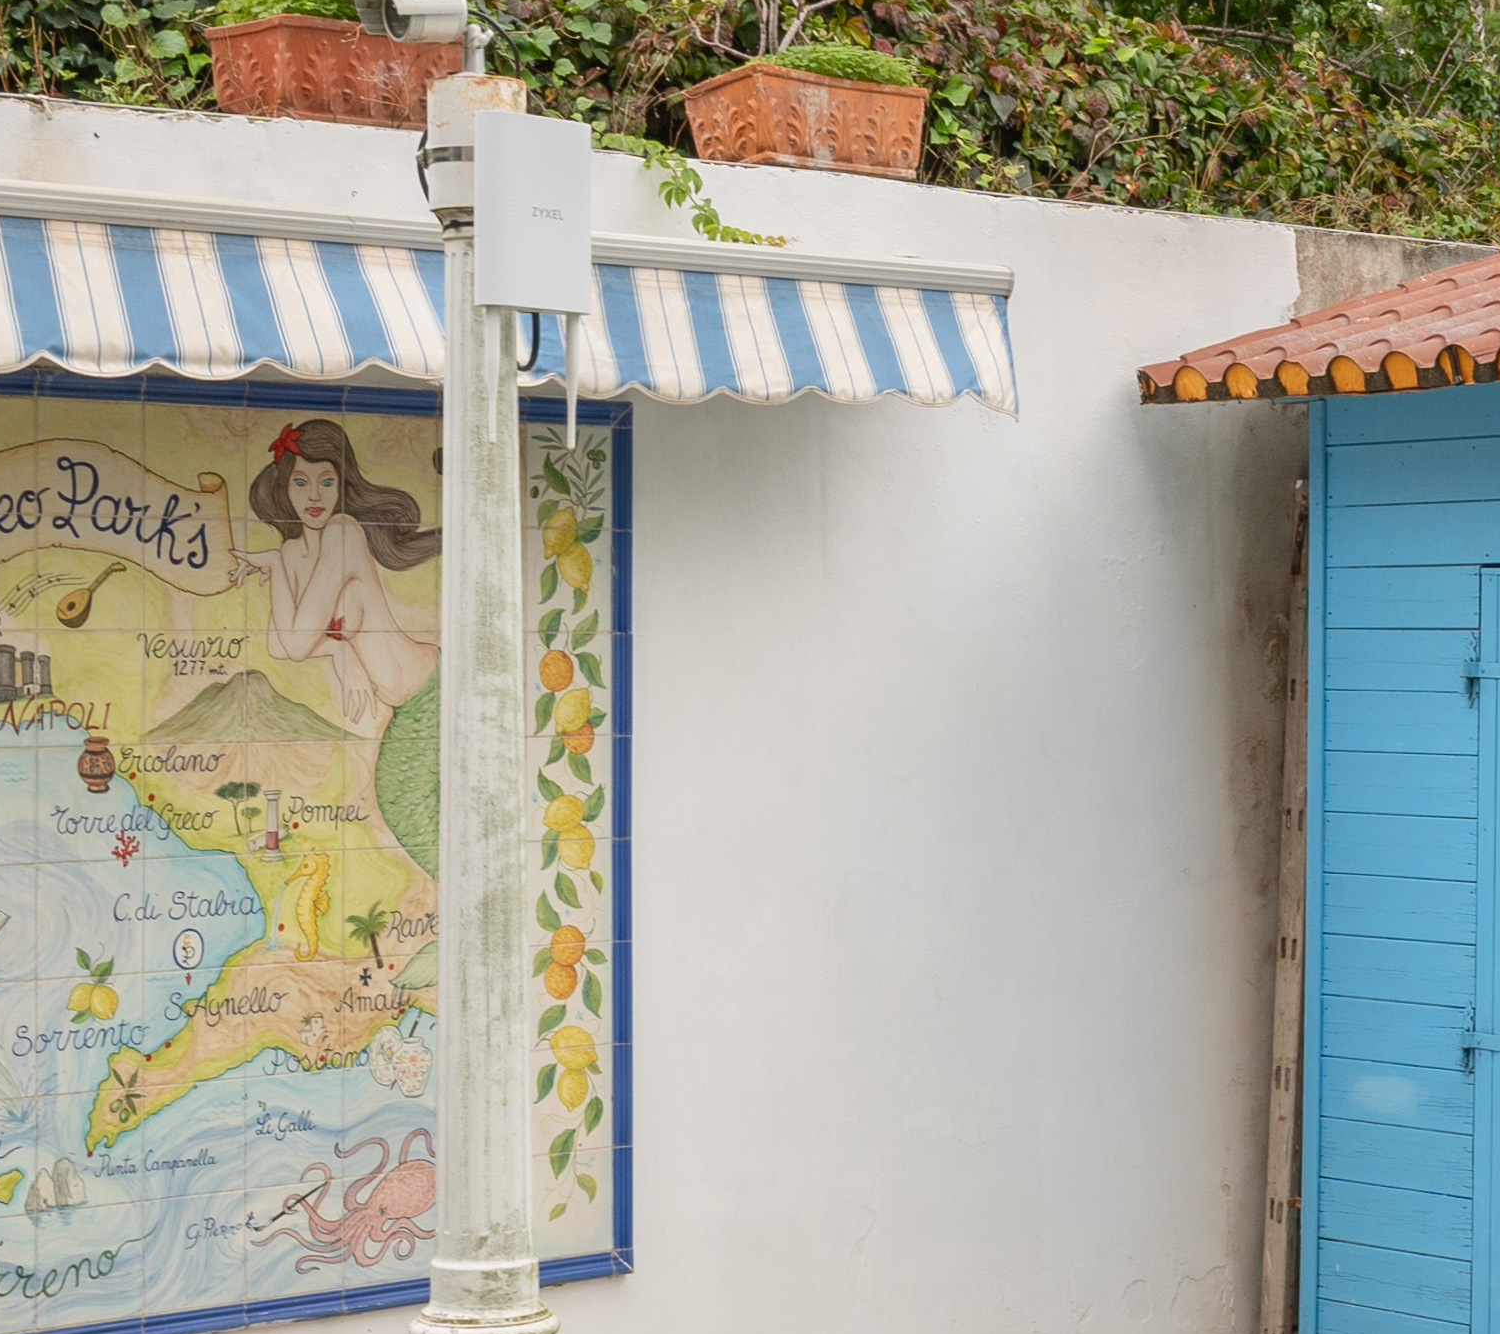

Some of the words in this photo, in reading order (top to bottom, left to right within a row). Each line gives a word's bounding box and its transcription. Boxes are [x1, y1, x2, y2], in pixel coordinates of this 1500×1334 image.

[531, 206, 564, 220] ZYXEL
[52, 456, 209, 569] Park's
[137, 626, 250, 659] Vesuvio
[172, 660, 206, 676] 1277
[117, 745, 226, 773] Ercolano
[50, 805, 117, 834] Torre
[120, 805, 154, 832] del
[156, 804, 218, 841] Greco
[282, 796, 370, 831] Pompei
[168, 890, 266, 920] Stabia
[387, 910, 439, 943] Rave
[12, 1021, 151, 1057] Sorrento
[262, 1044, 369, 1076] Positano
[275, 1110, 316, 1141] Galli
[94, 1154, 138, 1177] Punta
[143, 1149, 218, 1176] Campanella
